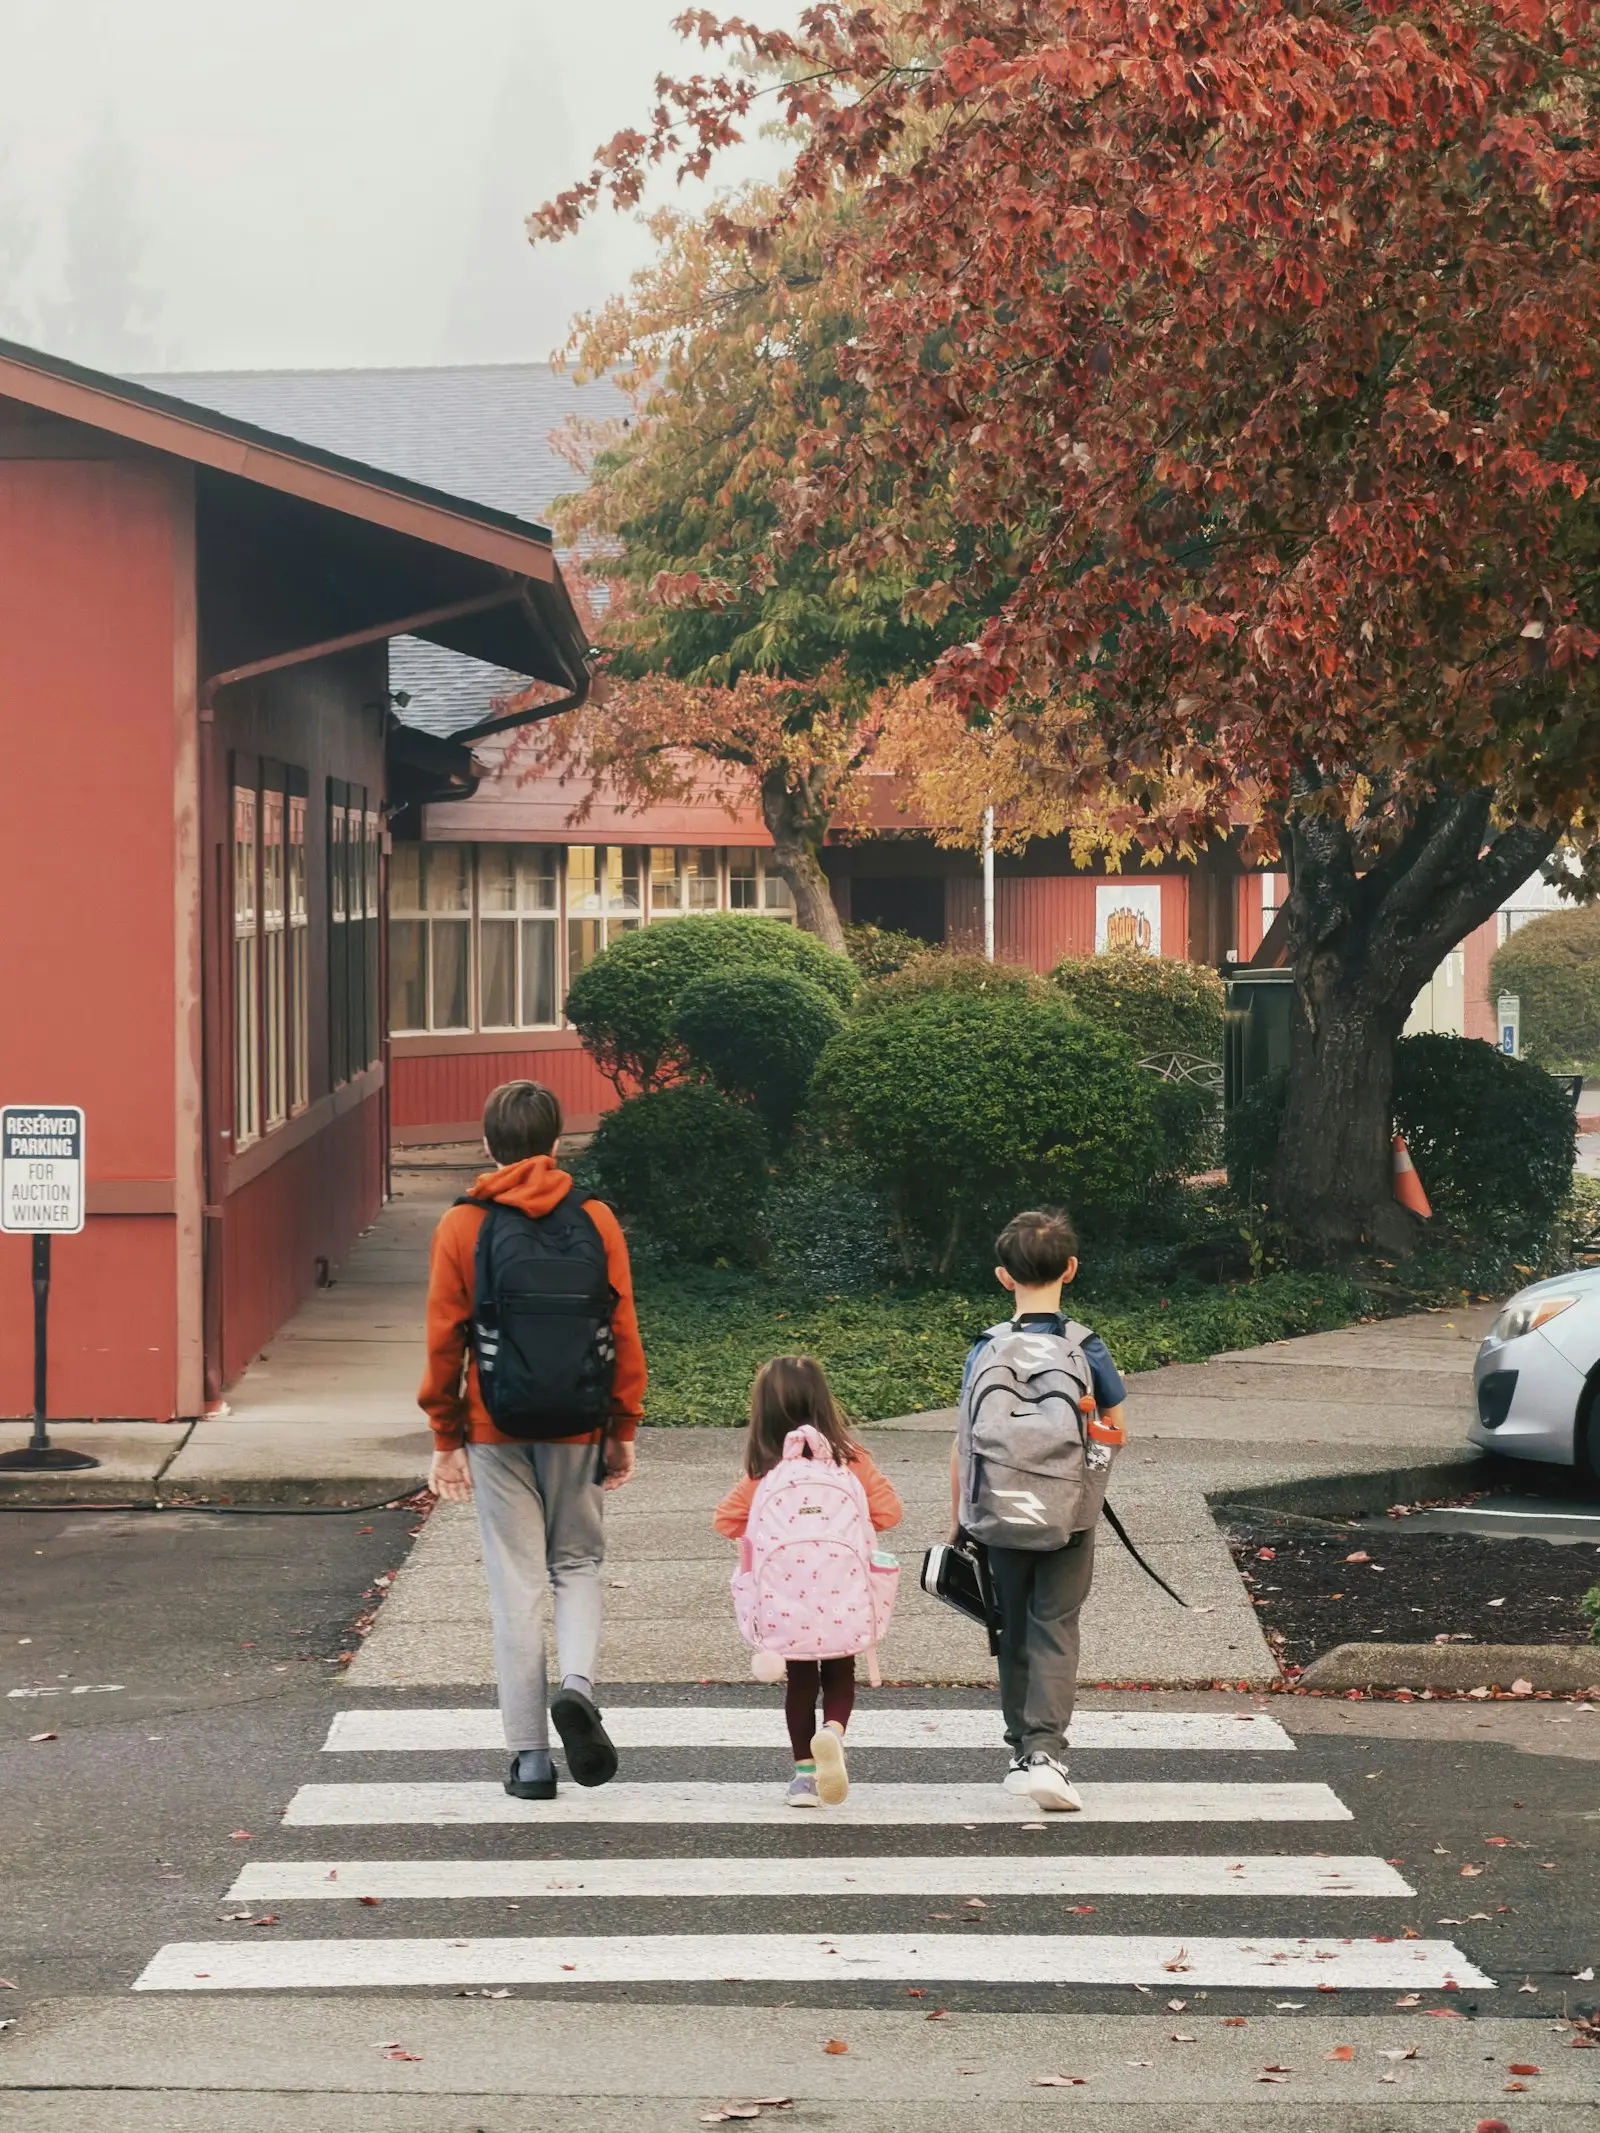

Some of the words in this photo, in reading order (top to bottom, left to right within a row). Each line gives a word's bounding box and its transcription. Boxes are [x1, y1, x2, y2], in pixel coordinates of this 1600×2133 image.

[6, 1117, 76, 1135] RESERVED
[10, 1138, 72, 1156] PARKING
[28, 1163, 54, 1180] FOR
[11, 1184, 71, 1201] AUCTION
[12, 1205, 69, 1221] WINNER
